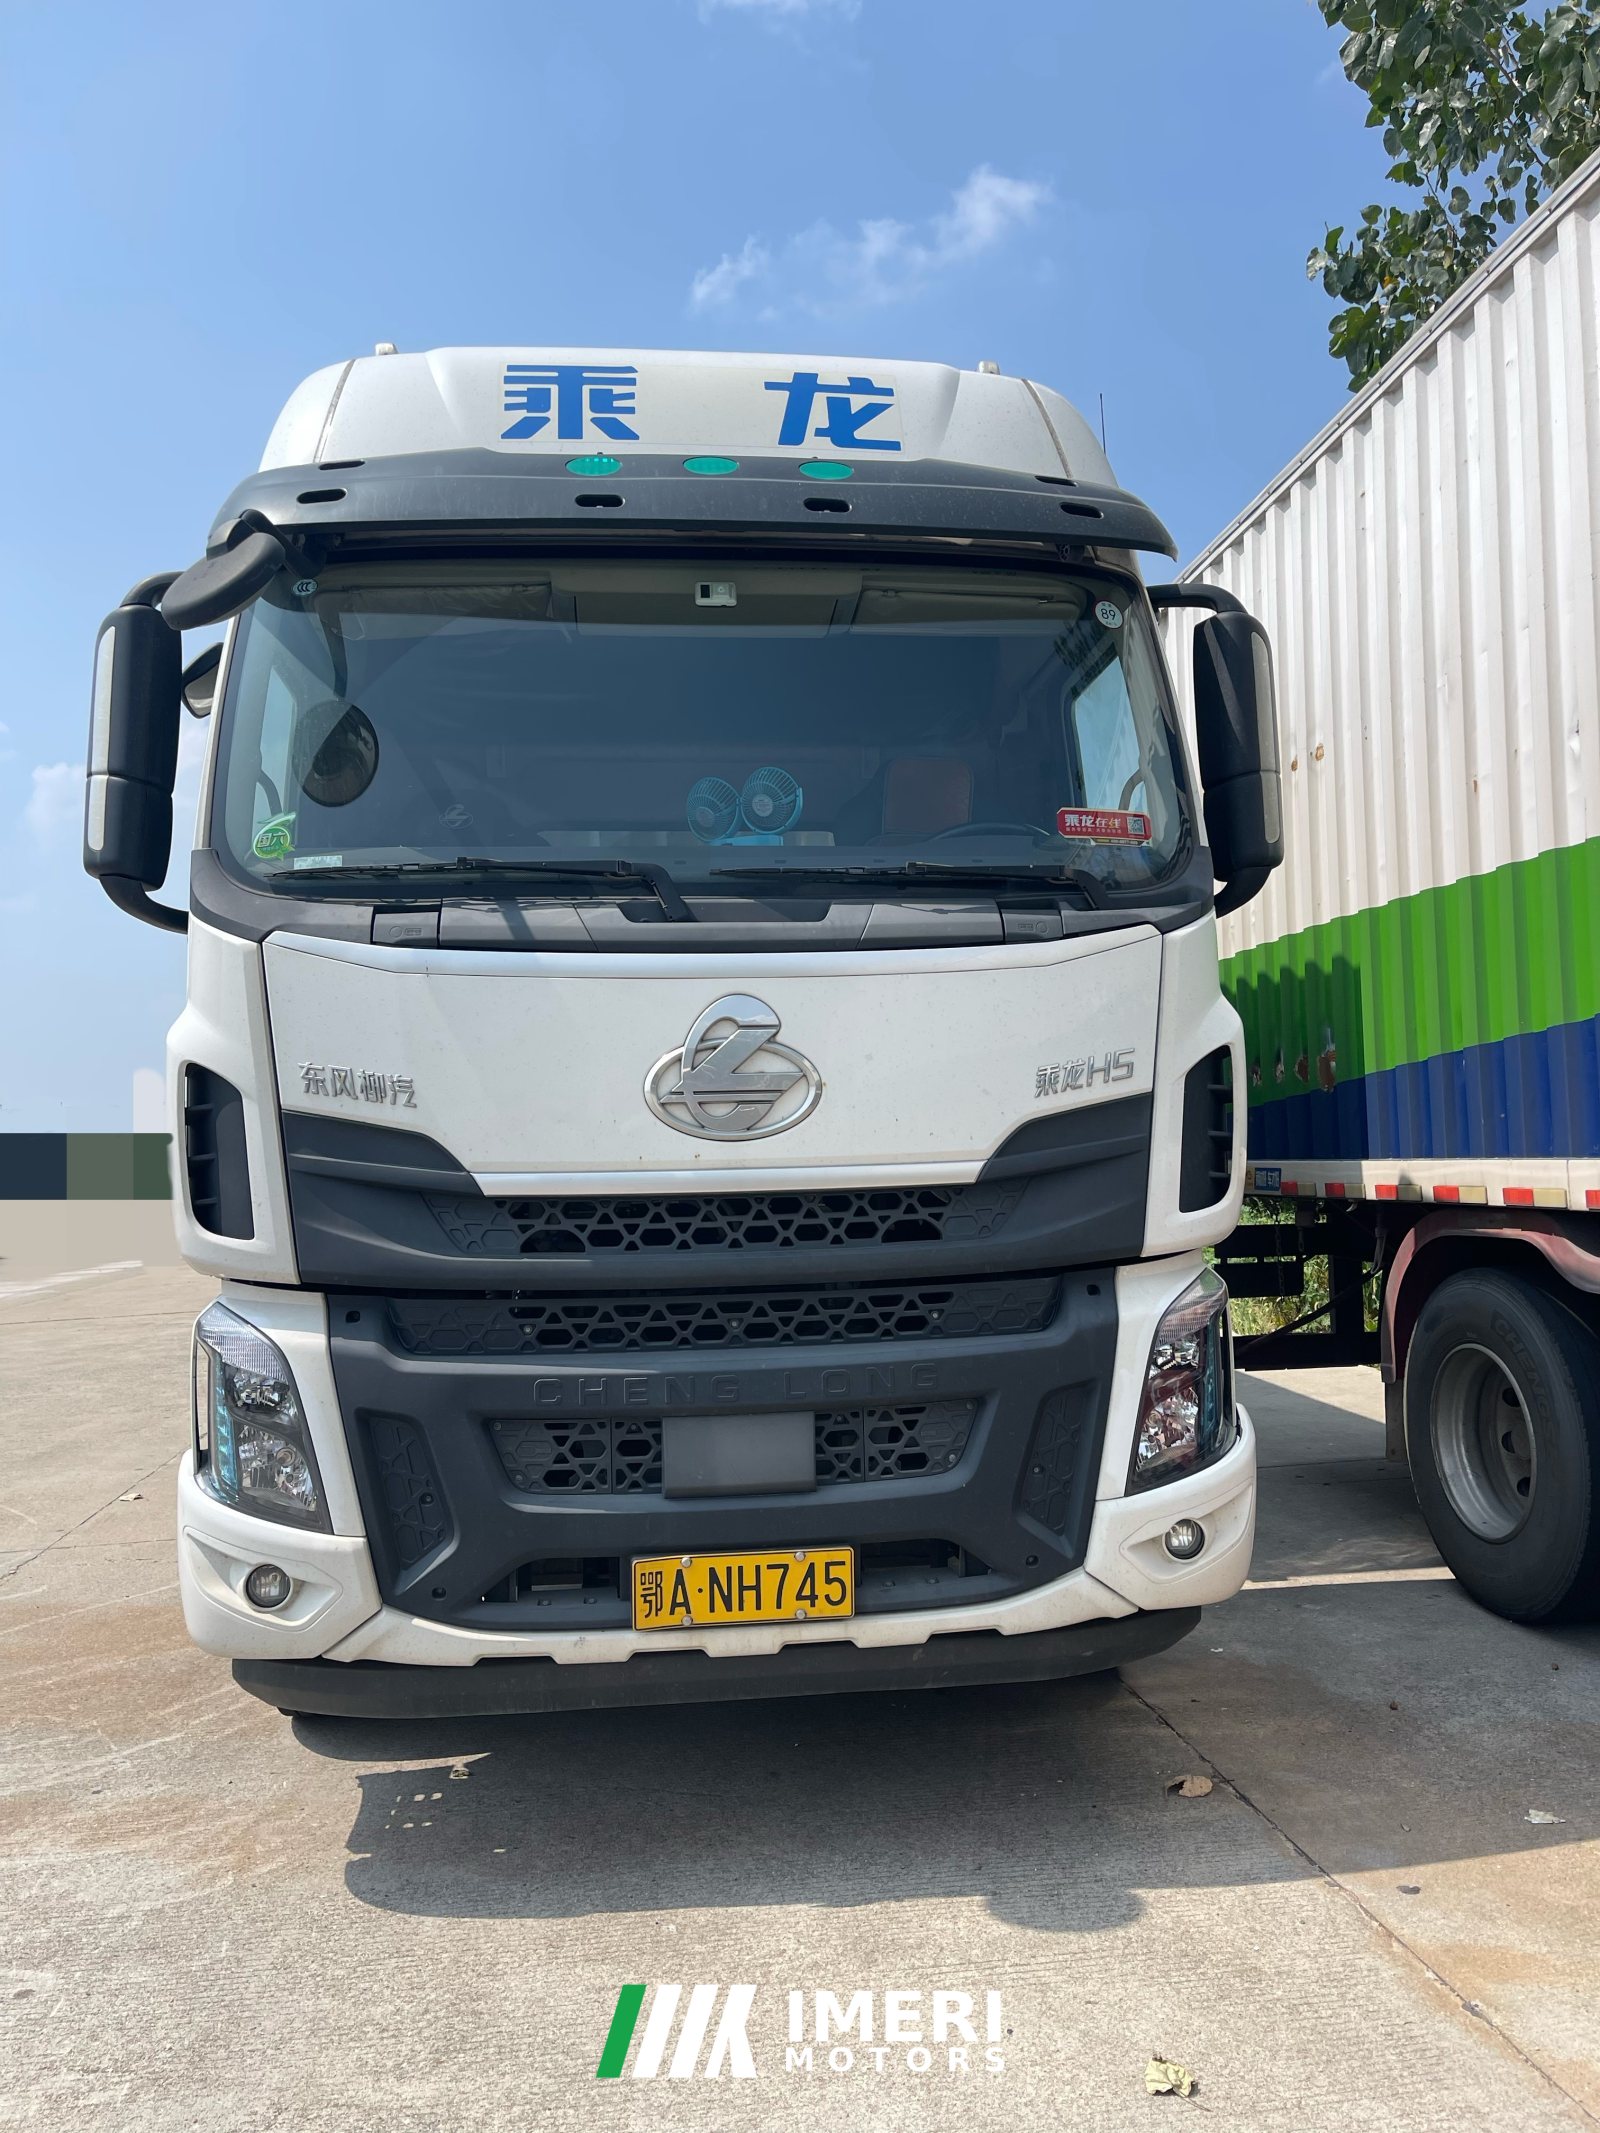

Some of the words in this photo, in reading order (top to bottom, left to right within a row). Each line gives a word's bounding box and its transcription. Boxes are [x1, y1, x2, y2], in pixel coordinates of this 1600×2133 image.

[500, 364, 902, 452] 乘龙
[1101, 608, 1116, 620] 89
[1064, 813, 1121, 829] 乘龙在线
[257, 832, 286, 848] 国六
[297, 1061, 418, 1108] 东风柳汽
[532, 1374, 740, 1406] CHENG
[783, 1362, 938, 1400] LONG
